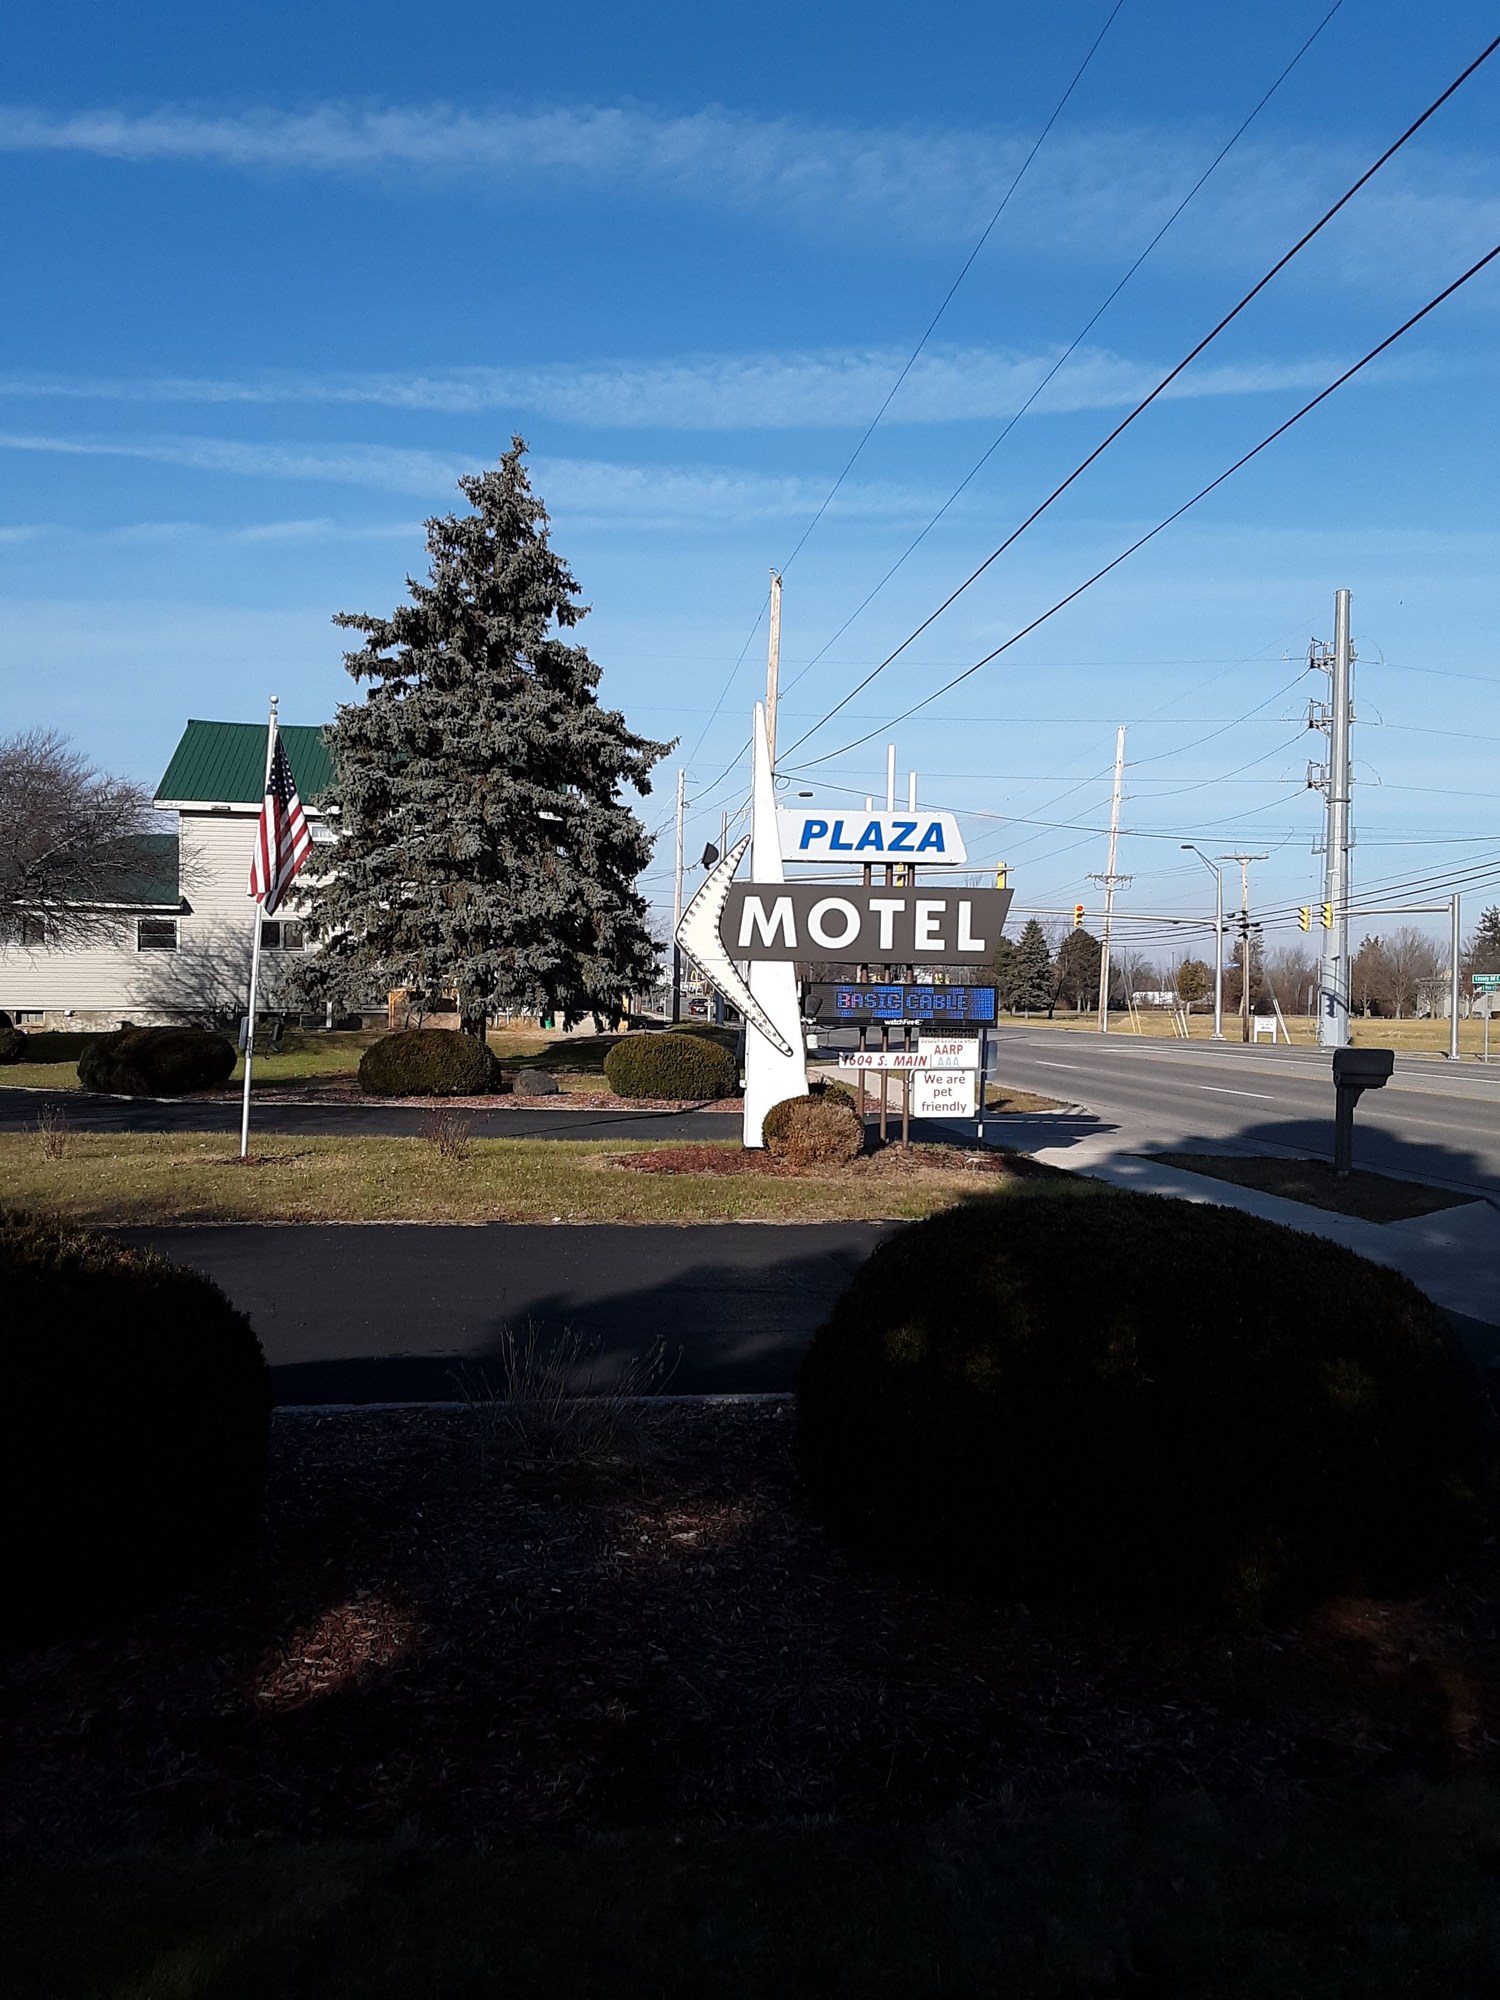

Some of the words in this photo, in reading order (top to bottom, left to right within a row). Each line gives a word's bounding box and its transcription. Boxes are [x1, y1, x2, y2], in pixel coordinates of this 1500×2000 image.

[799, 820, 945, 852] PLAZA
[738, 896, 986, 952] MOTEL
[837, 993, 900, 1009] BASIC
[906, 994, 968, 1010] CABLE
[934, 1044, 963, 1055] AARP
[893, 1055, 928, 1067] MAIN
[937, 1056, 960, 1066] AAA
[924, 1074, 943, 1084] We
[946, 1076, 966, 1084] are
[933, 1087, 952, 1098] pet
[922, 1101, 967, 1113] friendly
